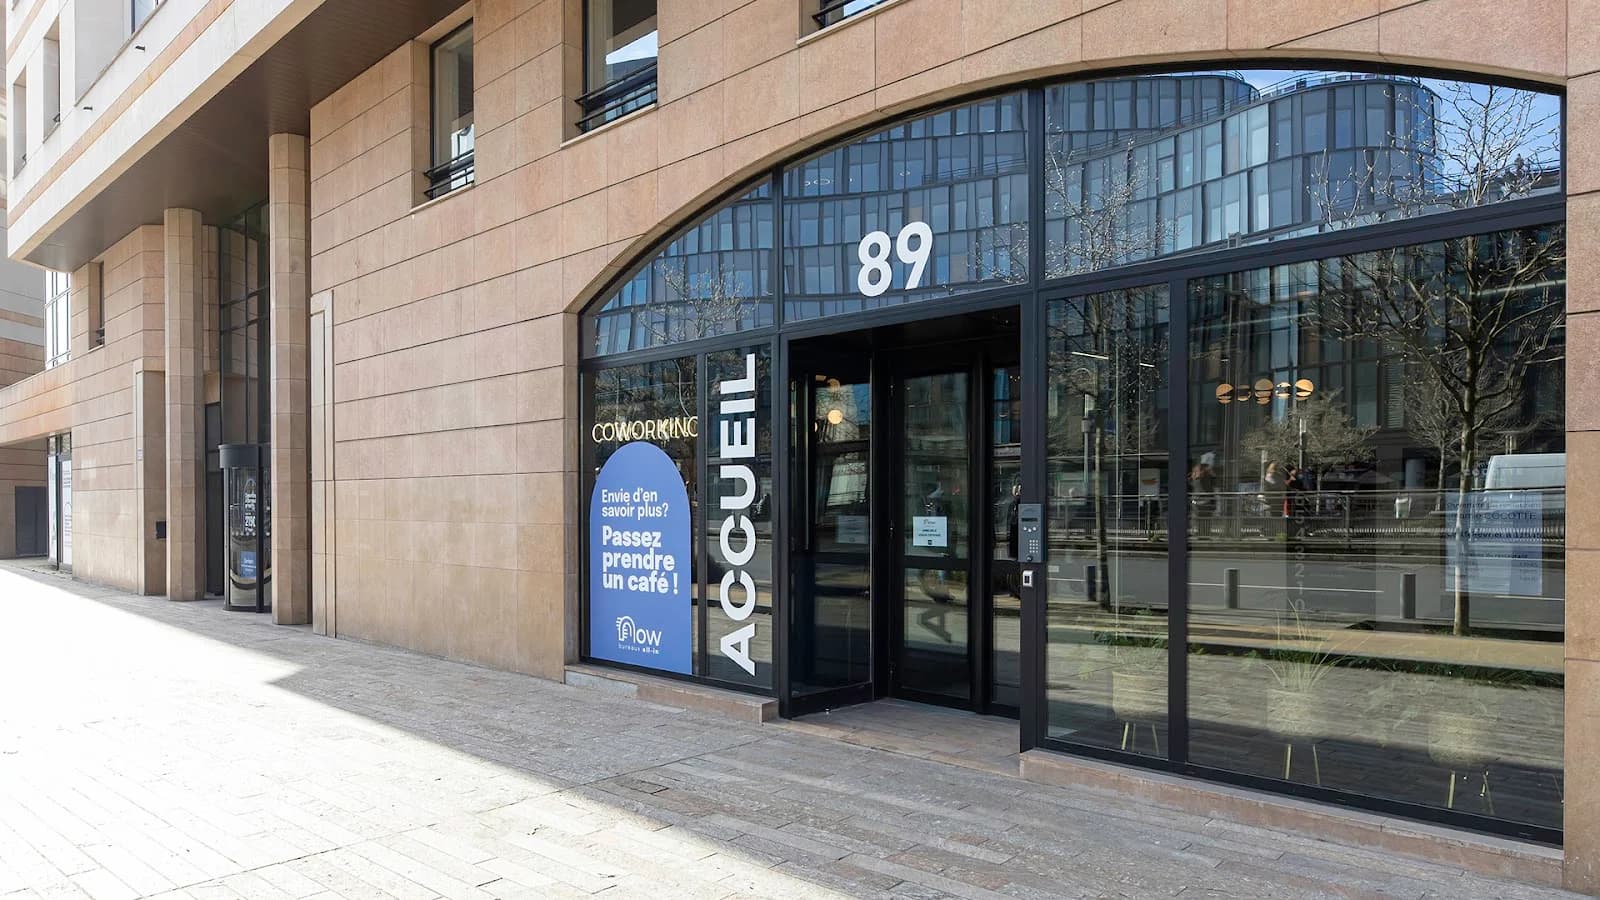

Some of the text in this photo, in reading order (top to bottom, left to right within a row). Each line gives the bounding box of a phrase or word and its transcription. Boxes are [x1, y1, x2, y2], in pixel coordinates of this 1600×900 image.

[858, 221, 933, 297] 89
[601, 486, 658, 503] Envie d'en
[601, 501, 669, 520] savoir plus?
[720, 352, 756, 677] ACCUEIL
[602, 525, 662, 548] Passez
[602, 547, 676, 573] prendre
[602, 573, 624, 590] un
[627, 570, 669, 594] café
